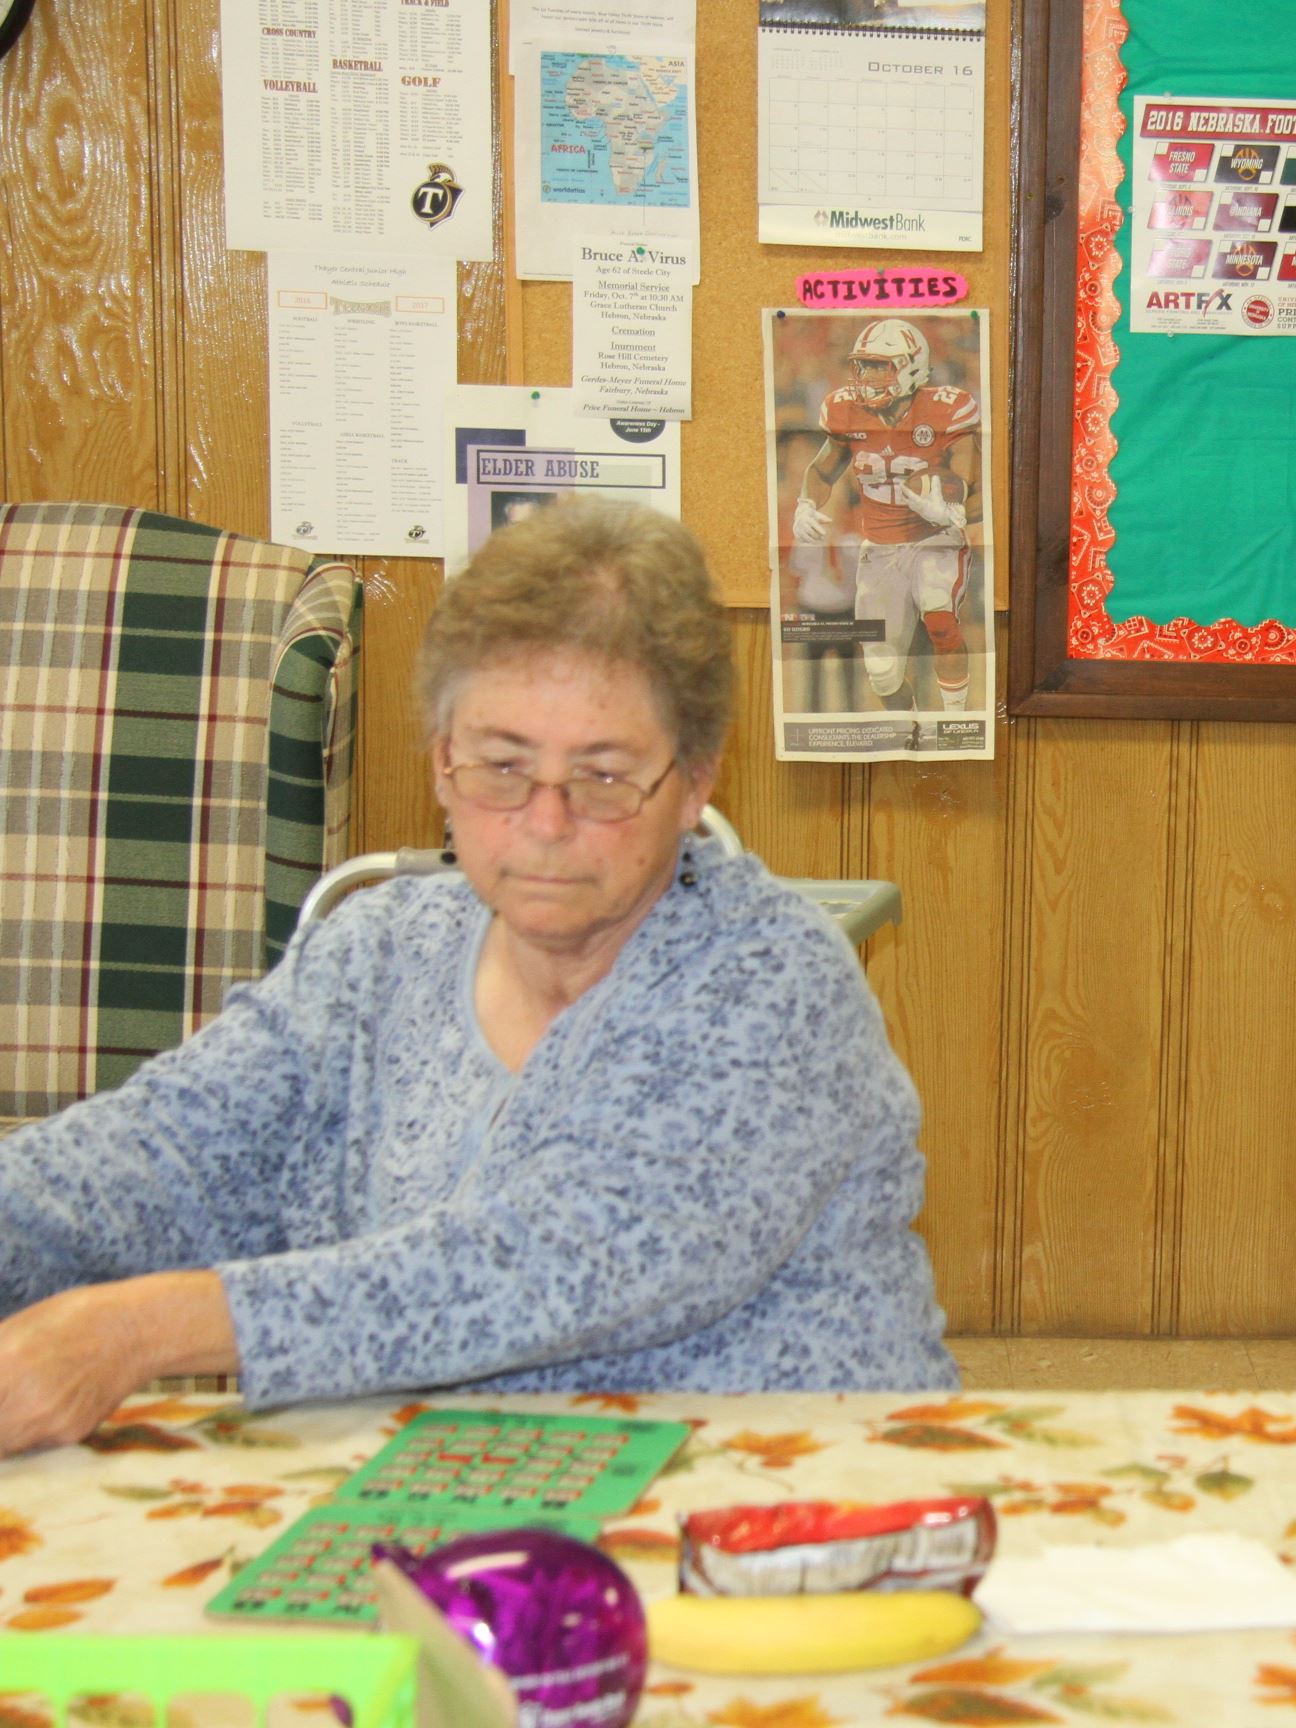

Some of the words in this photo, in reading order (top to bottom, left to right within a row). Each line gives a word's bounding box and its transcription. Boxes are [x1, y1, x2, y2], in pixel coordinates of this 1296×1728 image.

[262, 27, 284, 37] CROSS
[285, 29, 316, 39] COUNTRY
[332, 58, 384, 72] BASKETBALL
[954, 66, 973, 76] 16
[264, 79, 318, 94] VOLLEYBALL
[401, 75, 442, 88] GOLF
[1147, 110, 1184, 131] 2016
[1188, 112, 1260, 133] NEBRASKA
[551, 144, 586, 154] AFRICA
[1169, 152, 1195, 162] FRESNO
[1169, 163, 1189, 173] STATE
[1231, 159, 1263, 169] WYOMING
[582, 247, 623, 261] Bruce
[648, 251, 686, 265] Virus
[1226, 255, 1263, 265] MINNESOTA
[596, 266, 611, 274] Age
[655, 268, 671, 277] City
[598, 280, 638, 290] Memorial
[640, 283, 670, 292] Service
[802, 277, 958, 300] ACTIVITIES
[584, 290, 610, 300] Friday,
[614, 302, 647, 310] Lutheran
[601, 311, 630, 320] Hebron,
[612, 326, 655, 336] Cremation
[611, 342, 656, 352] Inurnment
[634, 354, 668, 363] Cemetery
[600, 362, 630, 370] Hebron,
[633, 363, 666, 372] Nebraska
[481, 458, 535, 477] ELDER
[544, 460, 600, 478] ABUSE
